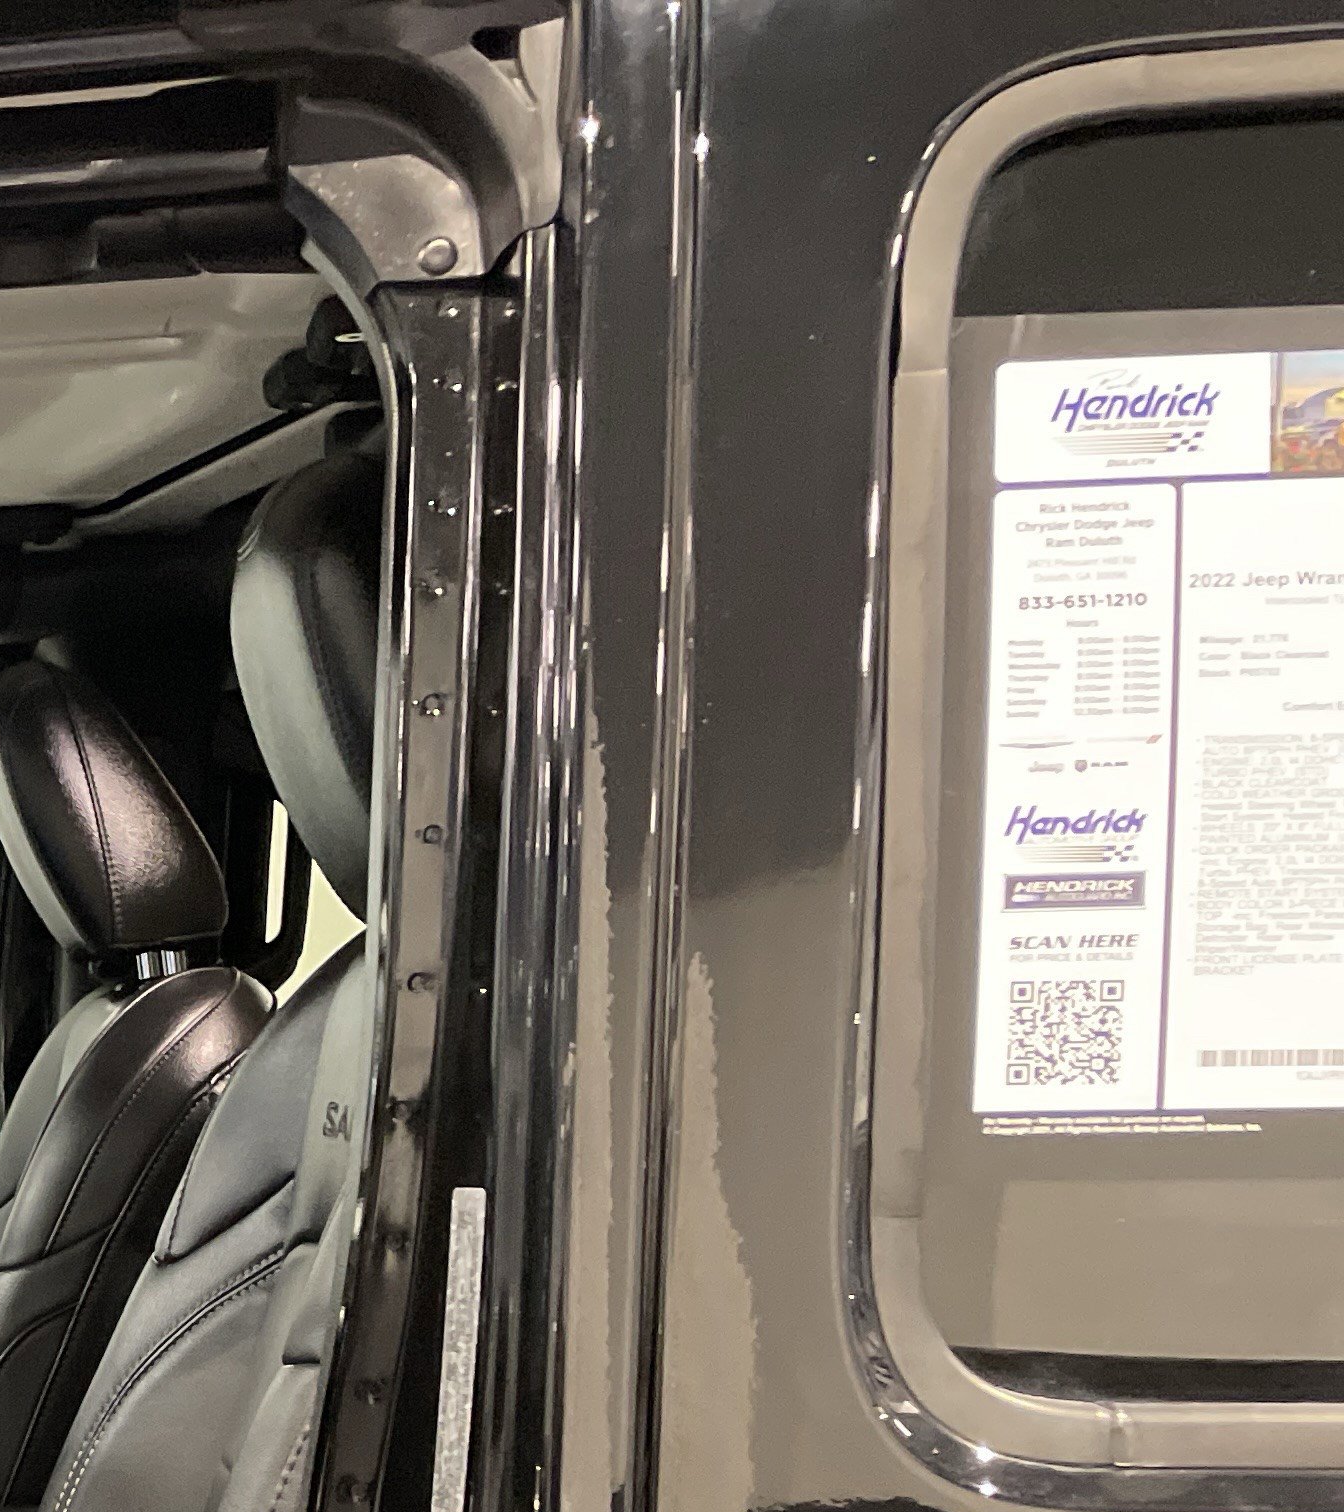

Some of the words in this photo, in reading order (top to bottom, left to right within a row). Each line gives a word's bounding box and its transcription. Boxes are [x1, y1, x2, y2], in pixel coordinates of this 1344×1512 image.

[1050, 383, 1220, 433] Hendrick
[1189, 572, 1235, 588] 2022
[1242, 572, 1290, 589] Jeep
[1018, 593, 1148, 610] 833-651-1210
[1004, 805, 1148, 845] Hendrick
[1014, 880, 1135, 892] HENDRICK
[1009, 936, 1071, 950] SCAN
[1079, 934, 1140, 948] HERE
